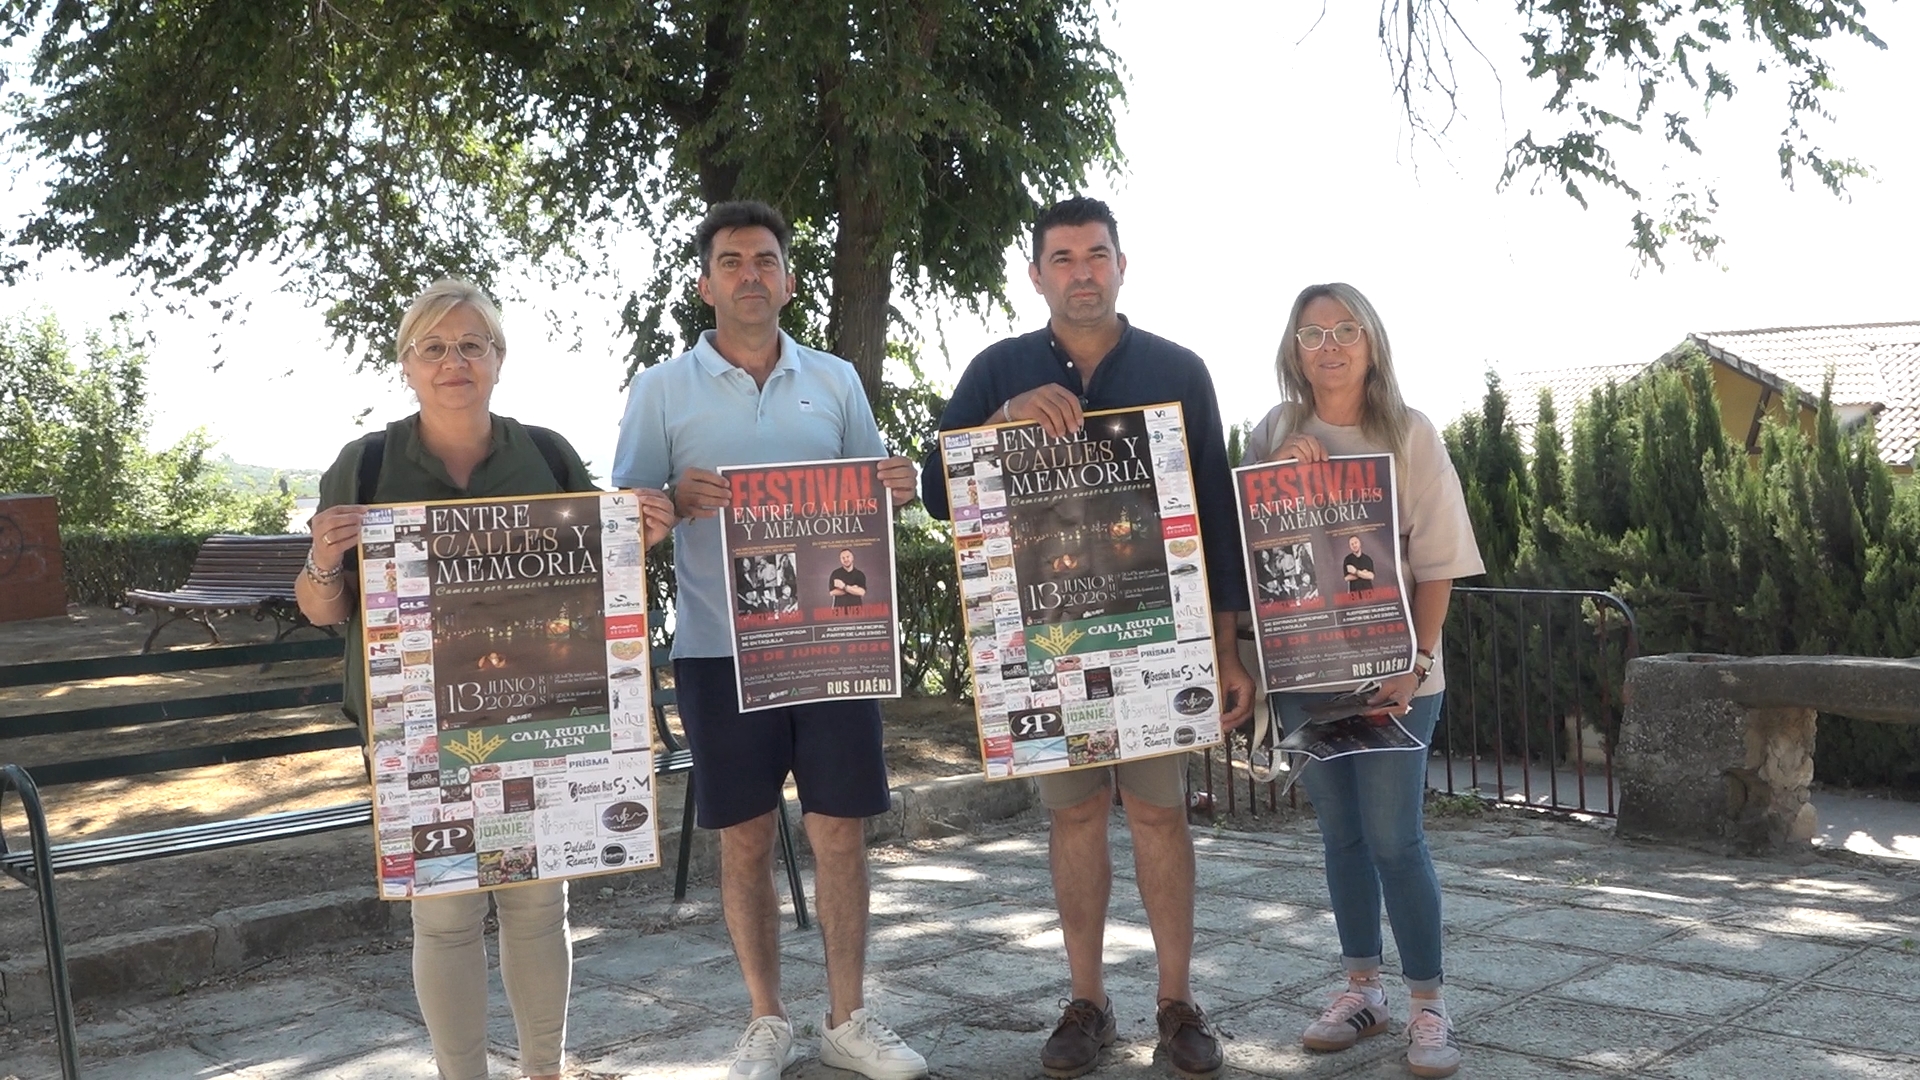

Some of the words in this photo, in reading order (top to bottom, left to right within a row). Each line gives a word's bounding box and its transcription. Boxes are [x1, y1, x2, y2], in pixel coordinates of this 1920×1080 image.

[1006, 440, 1114, 474] CALLES
[1122, 436, 1139, 459] Y
[1010, 459, 1150, 497] MEMORIA
[731, 465, 878, 516] FESTIVAL
[1011, 497, 1048, 506] Camino
[1052, 494, 1069, 503] por
[1072, 488, 1110, 498] nuestra
[1112, 483, 1151, 493] historia
[733, 503, 795, 524] ENTRE
[801, 498, 878, 519] CALLES
[1249, 496, 1307, 520] ENTRE
[1312, 487, 1383, 510] CALLES
[431, 504, 530, 534] ENTRE
[742, 523, 755, 541] Y
[763, 516, 864, 540] MEMORIA
[1259, 519, 1270, 534] Y
[1279, 504, 1369, 532] MEMORIA
[432, 527, 559, 559] CALLES
[571, 525, 590, 549] Y
[434, 550, 598, 585] MEMORIA
[435, 585, 480, 596] Camino
[483, 584, 503, 594] por
[506, 580, 550, 591] nuestra
[553, 577, 598, 587] historia
[1061, 575, 1106, 593] JUNIO
[1028, 581, 1062, 611] 13
[1061, 591, 1107, 607] 2026
[1087, 624, 1123, 636] CAJA
[1125, 616, 1175, 631] RURAL
[1117, 627, 1153, 641] JAEN
[1287, 634, 1310, 646] DE
[1317, 628, 1361, 642] JUNIO
[1367, 623, 1406, 636] 2026
[741, 653, 758, 665] 13
[762, 650, 785, 662] DE
[792, 644, 841, 657] JUNIO
[848, 642, 890, 654] 2026
[1352, 663, 1373, 677] RUS
[446, 681, 485, 714] 13
[484, 676, 535, 696] JUNIO
[827, 680, 850, 695] RUS
[485, 693, 537, 711] 2026
[510, 729, 553, 743] CAJA
[555, 723, 611, 737] RURAL
[544, 736, 587, 750] JAEN
[563, 839, 597, 855] Pulpillo
